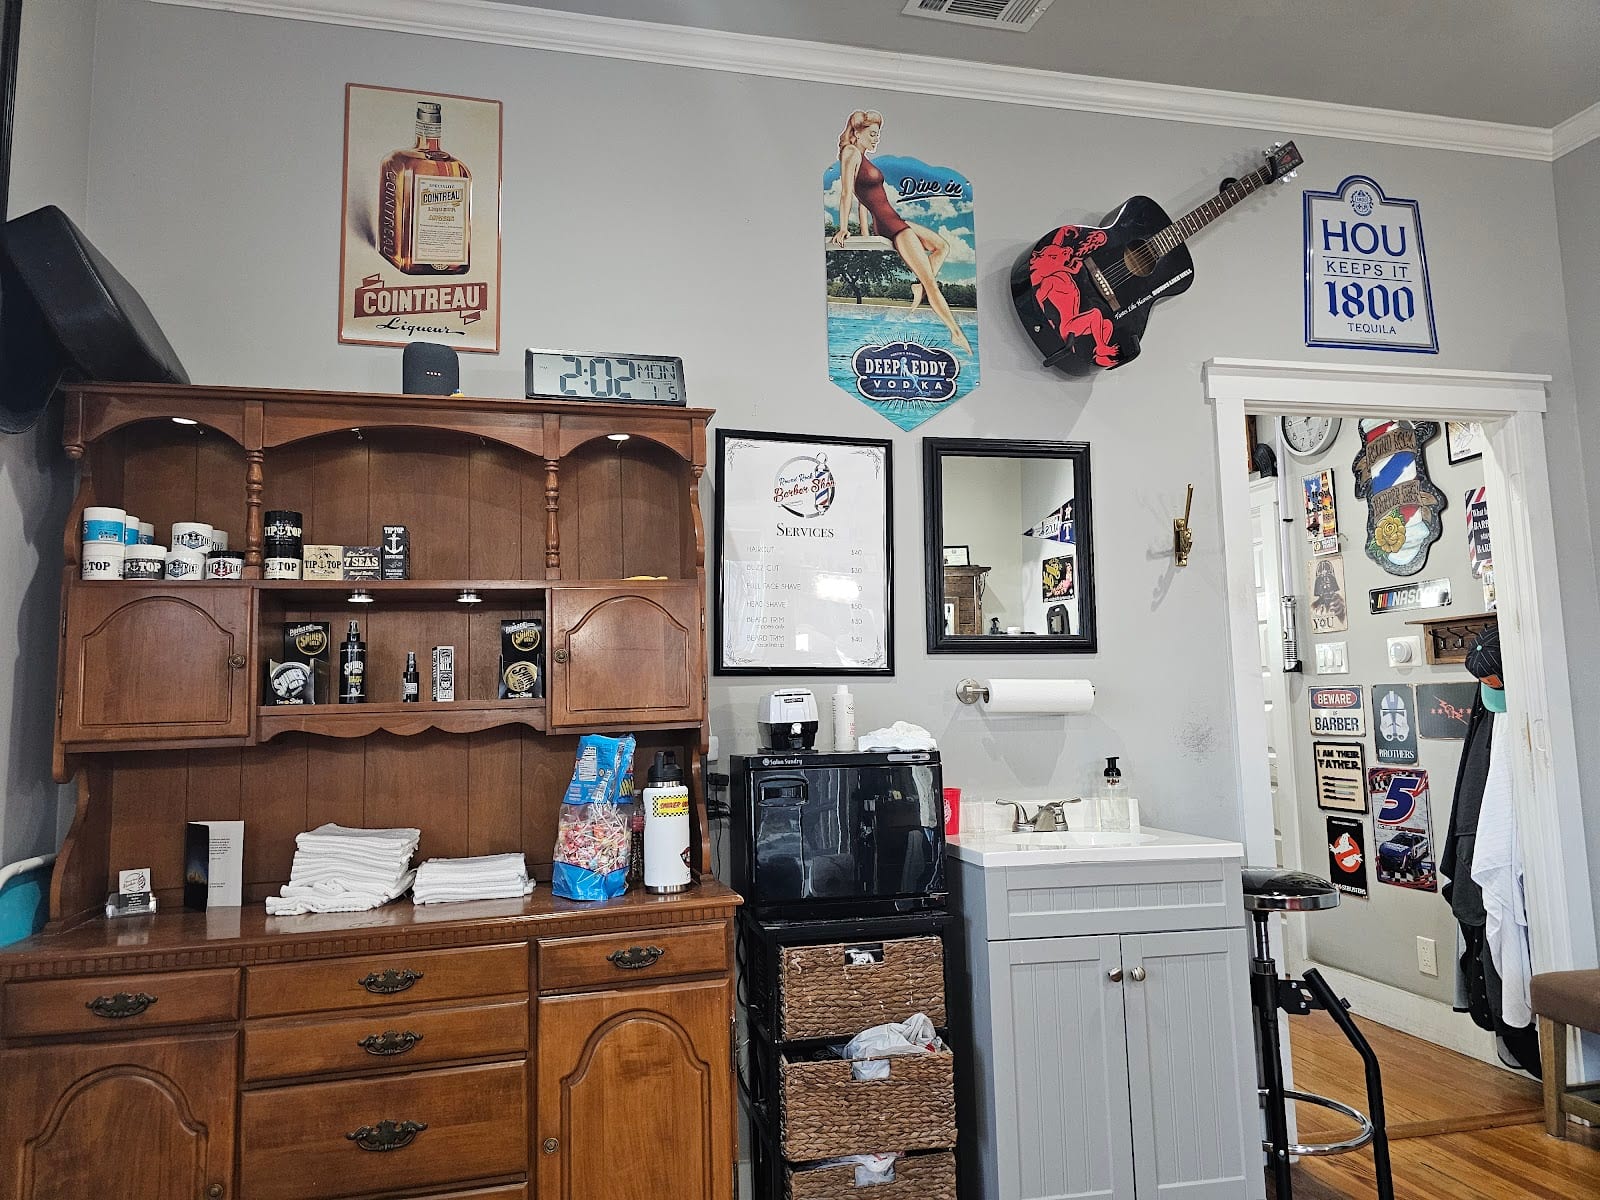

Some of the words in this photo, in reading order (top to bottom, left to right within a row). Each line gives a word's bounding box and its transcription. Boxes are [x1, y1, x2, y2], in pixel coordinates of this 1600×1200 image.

[899, 177, 940, 197] Dive
[946, 178, 963, 194] in
[383, 169, 398, 258] COINTREAU
[1322, 219, 1407, 257] HOU
[1326, 260, 1384, 277] KEEPS
[1393, 265, 1408, 278] IT
[363, 285, 480, 314] COINTREAU
[1324, 281, 1415, 322] 1800
[376, 317, 466, 336] Liqueur
[1347, 322, 1398, 335] TEQUILA
[637, 363, 676, 380] MON
[864, 358, 901, 375] DEEP
[910, 360, 948, 376] EDDY
[560, 356, 636, 399] 2:02
[873, 380, 943, 391] VODKA
[773, 483, 809, 502] Barber
[265, 526, 278, 537] TIP
[285, 526, 302, 537] TOP
[212, 541, 225, 551] OP
[89, 561, 111, 571] TOP
[138, 561, 162, 573] TOP
[278, 561, 297, 572] TOP
[304, 560, 318, 569] TIP
[326, 560, 342, 569] TOP
[344, 557, 352, 567] 7
[351, 557, 379, 567] SEAS
[180, 563, 200, 574] TOP
[780, 583, 801, 591] SHAVE
[1391, 587, 1441, 607] NASC
[766, 601, 786, 609] SHAVE
[769, 634, 785, 642] TRIM
[1317, 693, 1352, 705] BEWARE
[1314, 716, 1359, 731] BARBER
[1322, 749, 1334, 758] AM
[1336, 750, 1361, 759] THEIR
[1317, 759, 1361, 770] FATHER
[1377, 776, 1421, 824] 5
